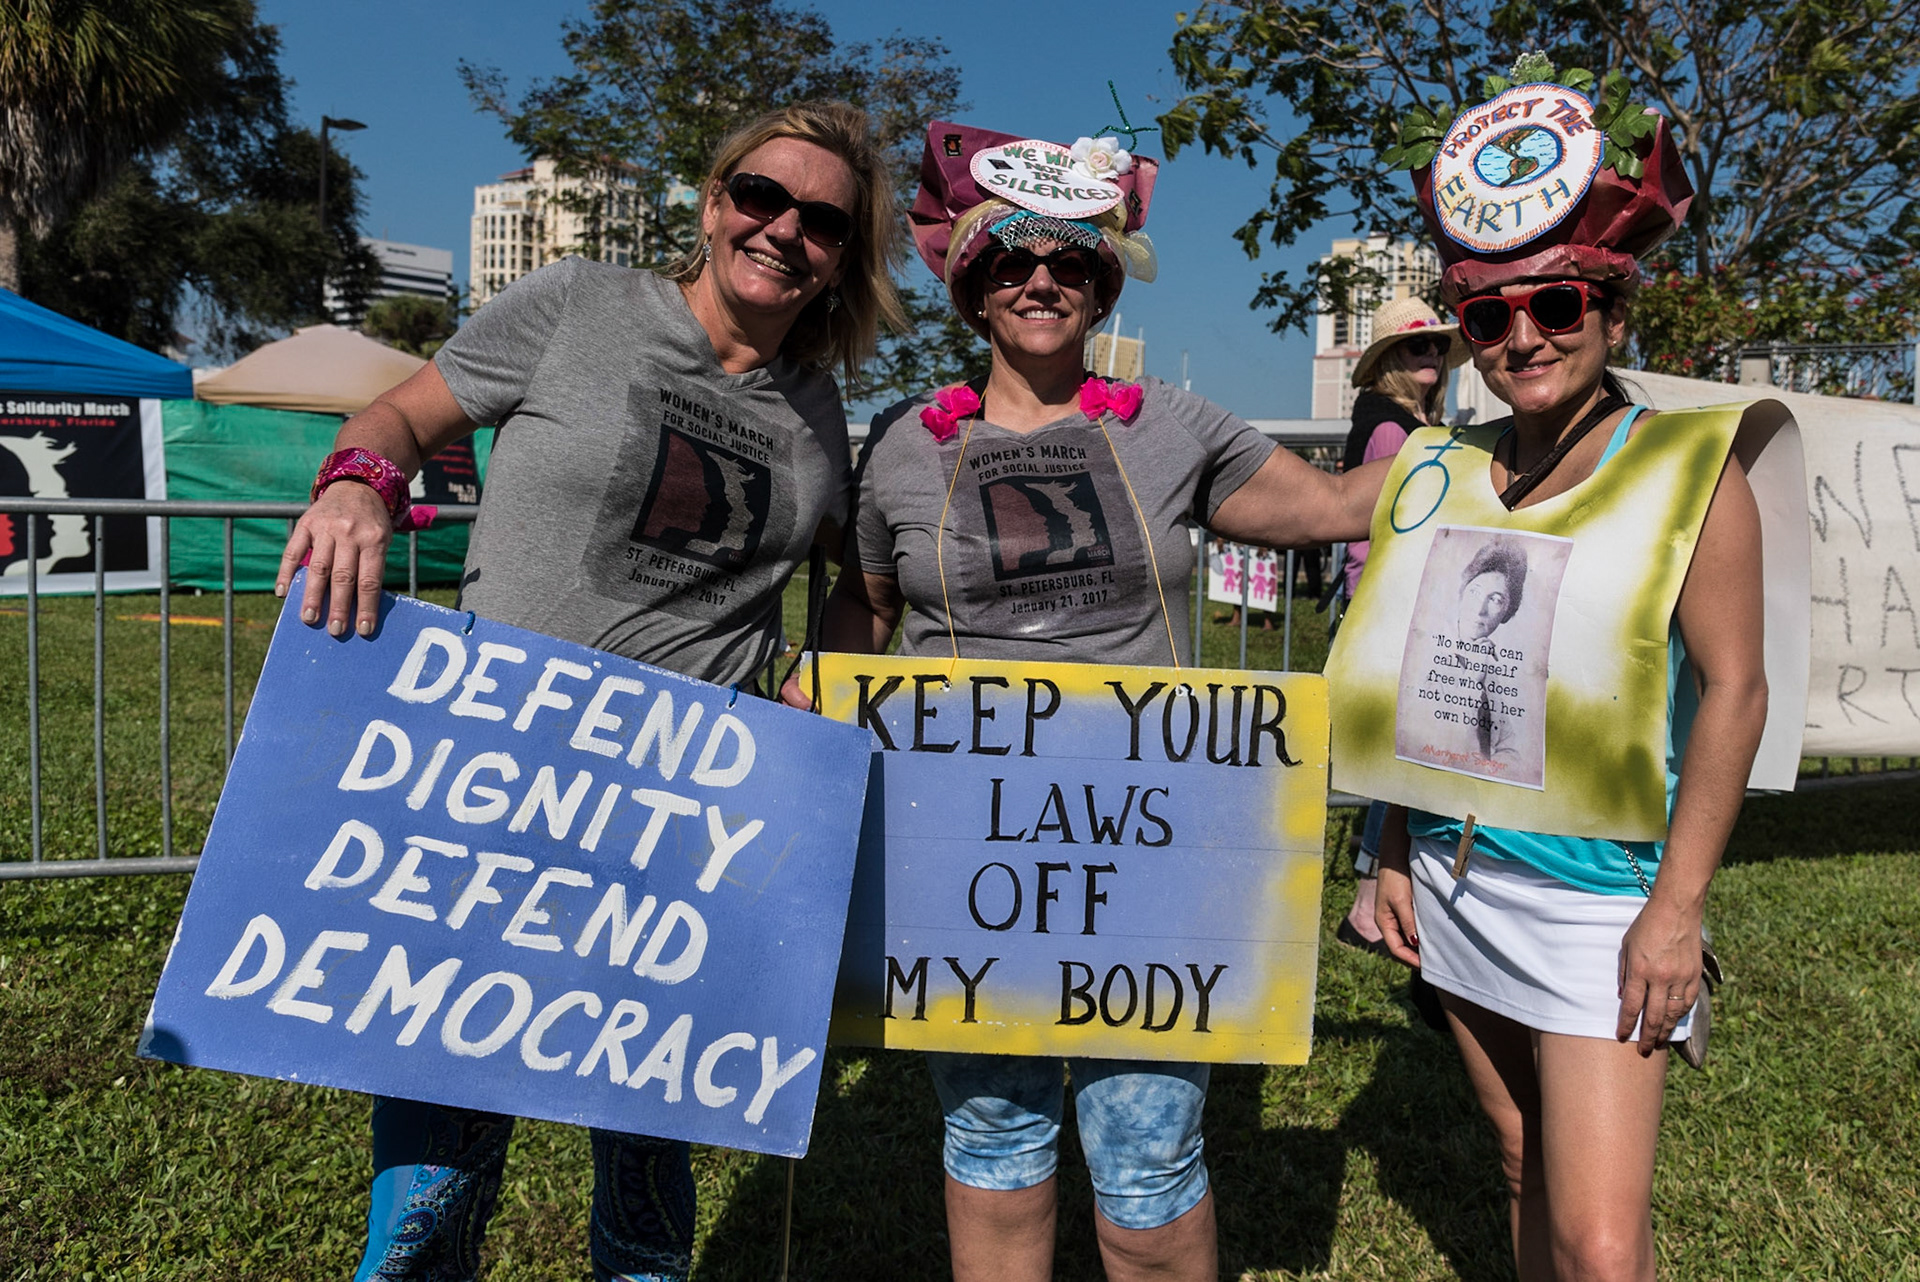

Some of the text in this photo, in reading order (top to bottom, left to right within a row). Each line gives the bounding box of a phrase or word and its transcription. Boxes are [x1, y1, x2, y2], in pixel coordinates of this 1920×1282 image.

[1442, 97, 1592, 159] PROTECT THE
[1003, 147, 1038, 161] WE
[1023, 161, 1068, 176] NOT
[988, 174, 1120, 201] SILENCED
[1438, 175, 1571, 234] EARTH
[6, 401, 81, 416] Solidarity
[84, 402, 130, 416] March
[66, 418, 115, 427] Florida
[660, 388, 774, 451] WOMEN'S MARCH
[663, 410, 770, 464] FOR SOCIAL JUSTICE
[969, 445, 1087, 470] WOMEN'S MARCH
[979, 462, 1086, 482] FOR SOCIAL JUSTICE
[626, 546, 643, 563] ST.
[723, 577, 736, 593] FL
[1000, 570, 1115, 598] ST. PETERSBURG, FL
[628, 568, 679, 593] January
[699, 588, 726, 606] 2017
[1011, 600, 1056, 614] January
[1082, 590, 1108, 605] 2017
[1433, 654, 1518, 679] call herself
[1456, 640, 1496, 656] woman
[1499, 648, 1524, 661] can
[1427, 669, 1519, 698] free who does
[387, 626, 756, 788] DEFEND
[1418, 688, 1526, 718] not control her
[1434, 710, 1459, 723] own
[854, 674, 1304, 768] KEEP YOUR
[337, 718, 764, 893] DIGNITY
[985, 778, 1173, 847] LAWS
[303, 819, 709, 984] DEFEND
[968, 861, 1118, 935] OFF
[882, 956, 1229, 1033] MY BODY
[204, 913, 816, 1124] DEMOCRACY
